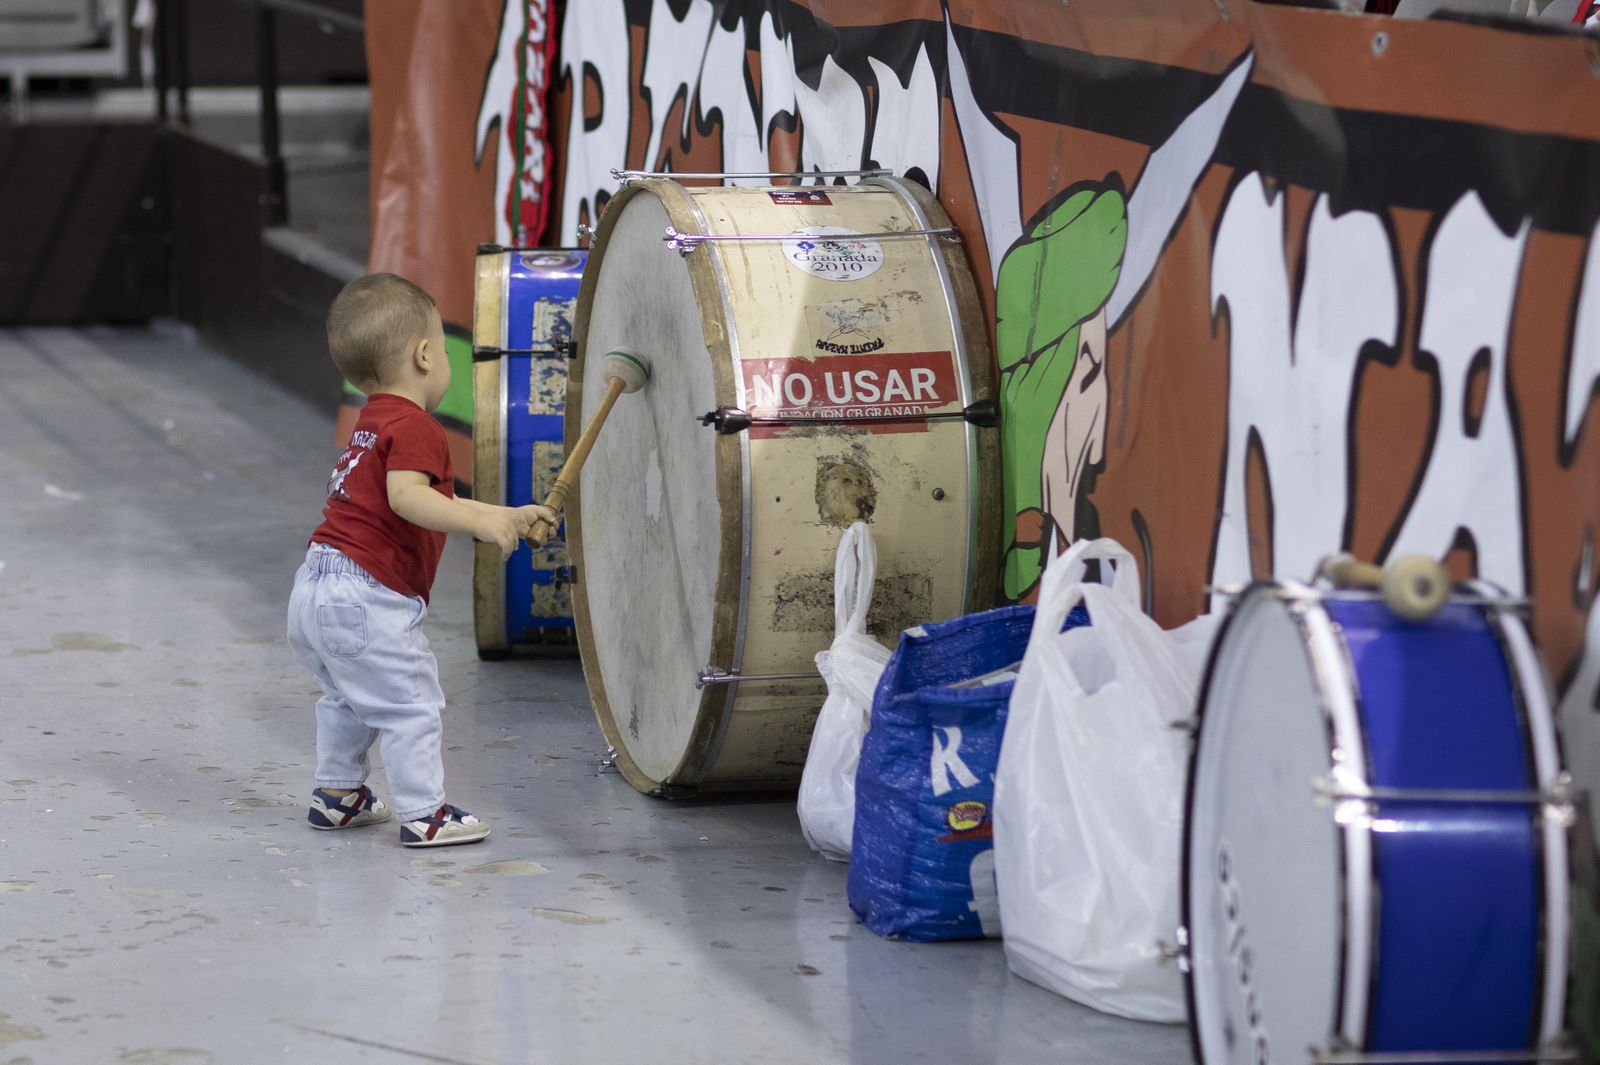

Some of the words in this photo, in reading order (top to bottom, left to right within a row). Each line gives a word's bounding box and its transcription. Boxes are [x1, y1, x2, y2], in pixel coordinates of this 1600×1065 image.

[793, 252, 878, 263] Granada
[811, 261, 863, 272] 2010
[849, 337, 885, 355] FRENTE
[752, 372, 814, 408] NO
[825, 367, 939, 404] USAR
[865, 405, 929, 418] GRANADA
